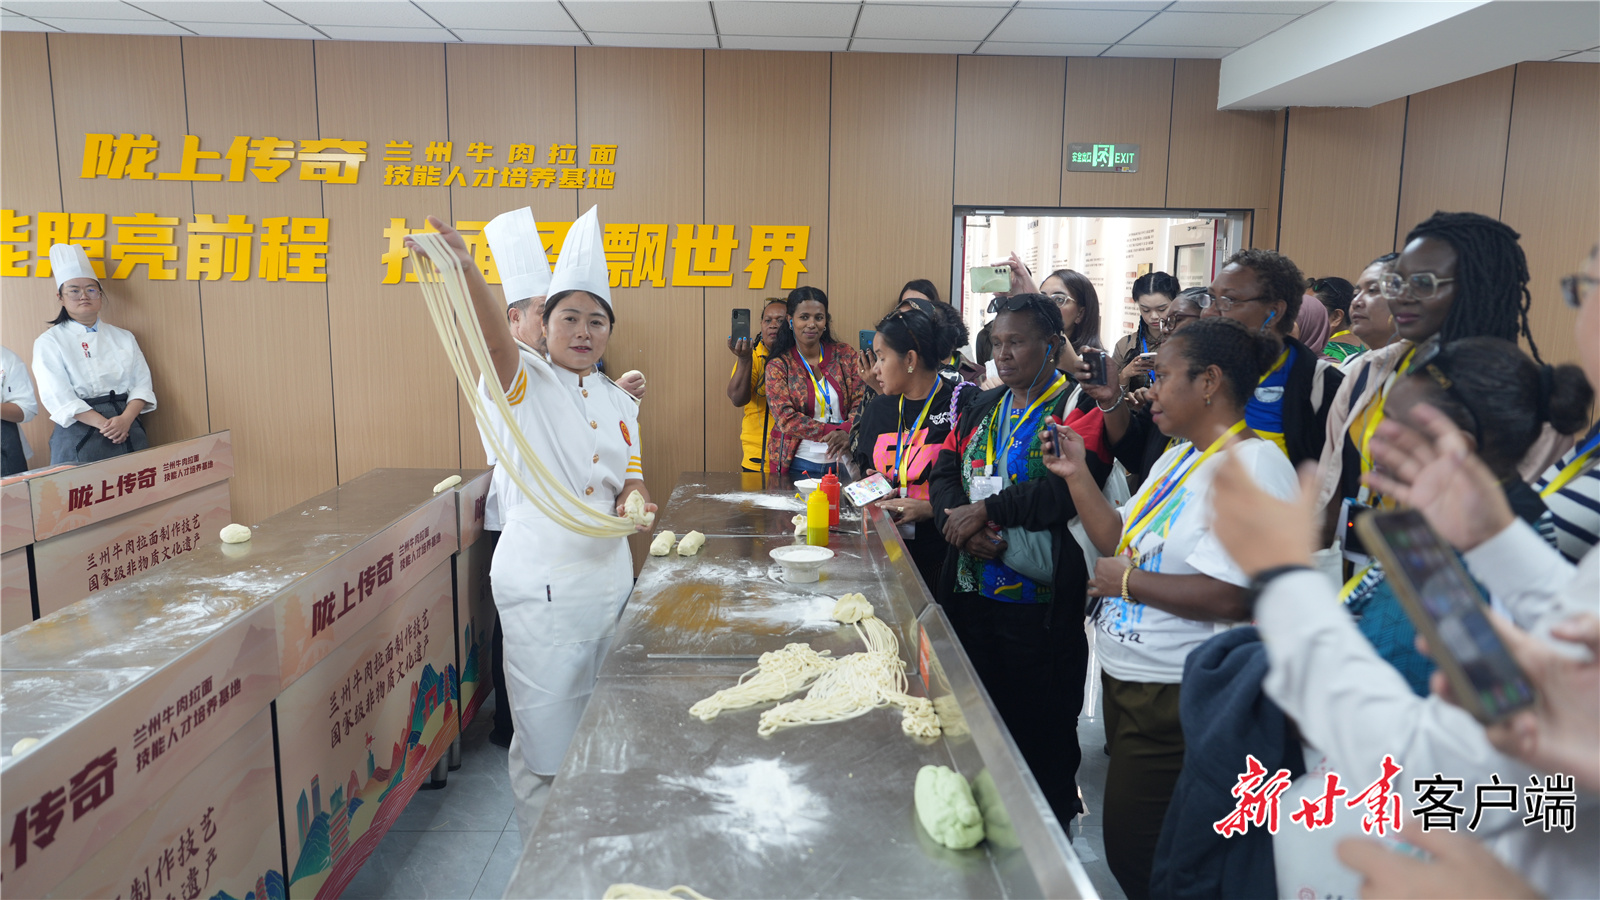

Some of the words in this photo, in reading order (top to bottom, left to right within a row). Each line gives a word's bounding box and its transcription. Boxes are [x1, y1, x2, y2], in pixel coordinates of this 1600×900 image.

[79, 132, 367, 184] 陇上传奇
[383, 140, 618, 165] 兰州牛肉拉面
[383, 165, 617, 189] 技能人才培养基地
[1072, 151, 1092, 163] 安全出口
[1114, 152, 1135, 164] EXIT
[68, 466, 157, 513] 陇上传奇
[163, 453, 200, 472] 兰州牛肉拉面
[164, 460, 214, 482] 技能人才培养基地
[86, 513, 201, 571] 兰州牛肉拉面制作技艺
[88, 535, 201, 592] 国家级非物质文化遗产
[311, 552, 395, 639] 陇上传奇
[329, 608, 430, 719] 兰州牛肉拉面制作技艺
[330, 634, 430, 750] 国家级非物质文化遗产
[133, 675, 213, 749] 兰州牛肉拉面
[136, 677, 242, 774] 技能人才培养基地
[0, 747, 118, 882] 传奇
[115, 807, 217, 900] 制作技艺
